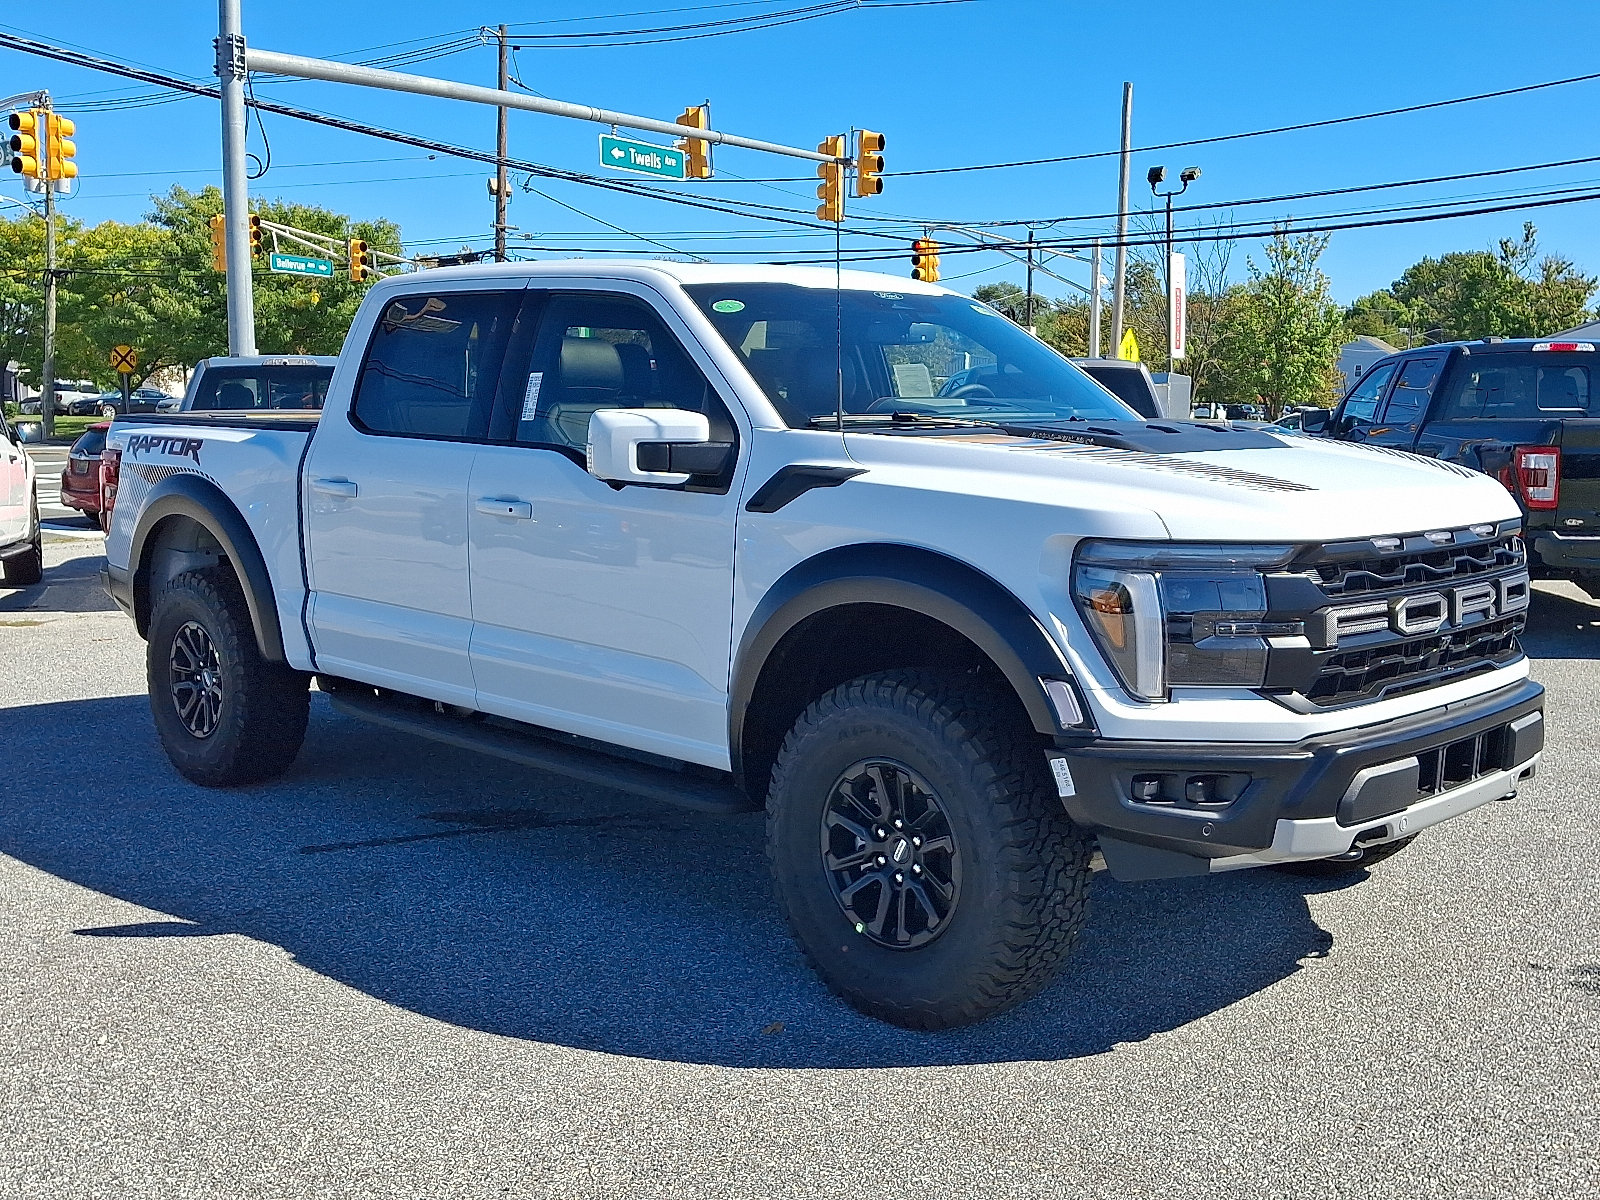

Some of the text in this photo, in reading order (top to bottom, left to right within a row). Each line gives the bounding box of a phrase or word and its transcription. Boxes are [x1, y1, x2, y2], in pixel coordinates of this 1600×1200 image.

[629, 147, 677, 169] Twells Ave
[275, 257, 306, 271] Bellevue
[126, 435, 204, 466] RAPTOR
[1325, 571, 1530, 648] FORD
